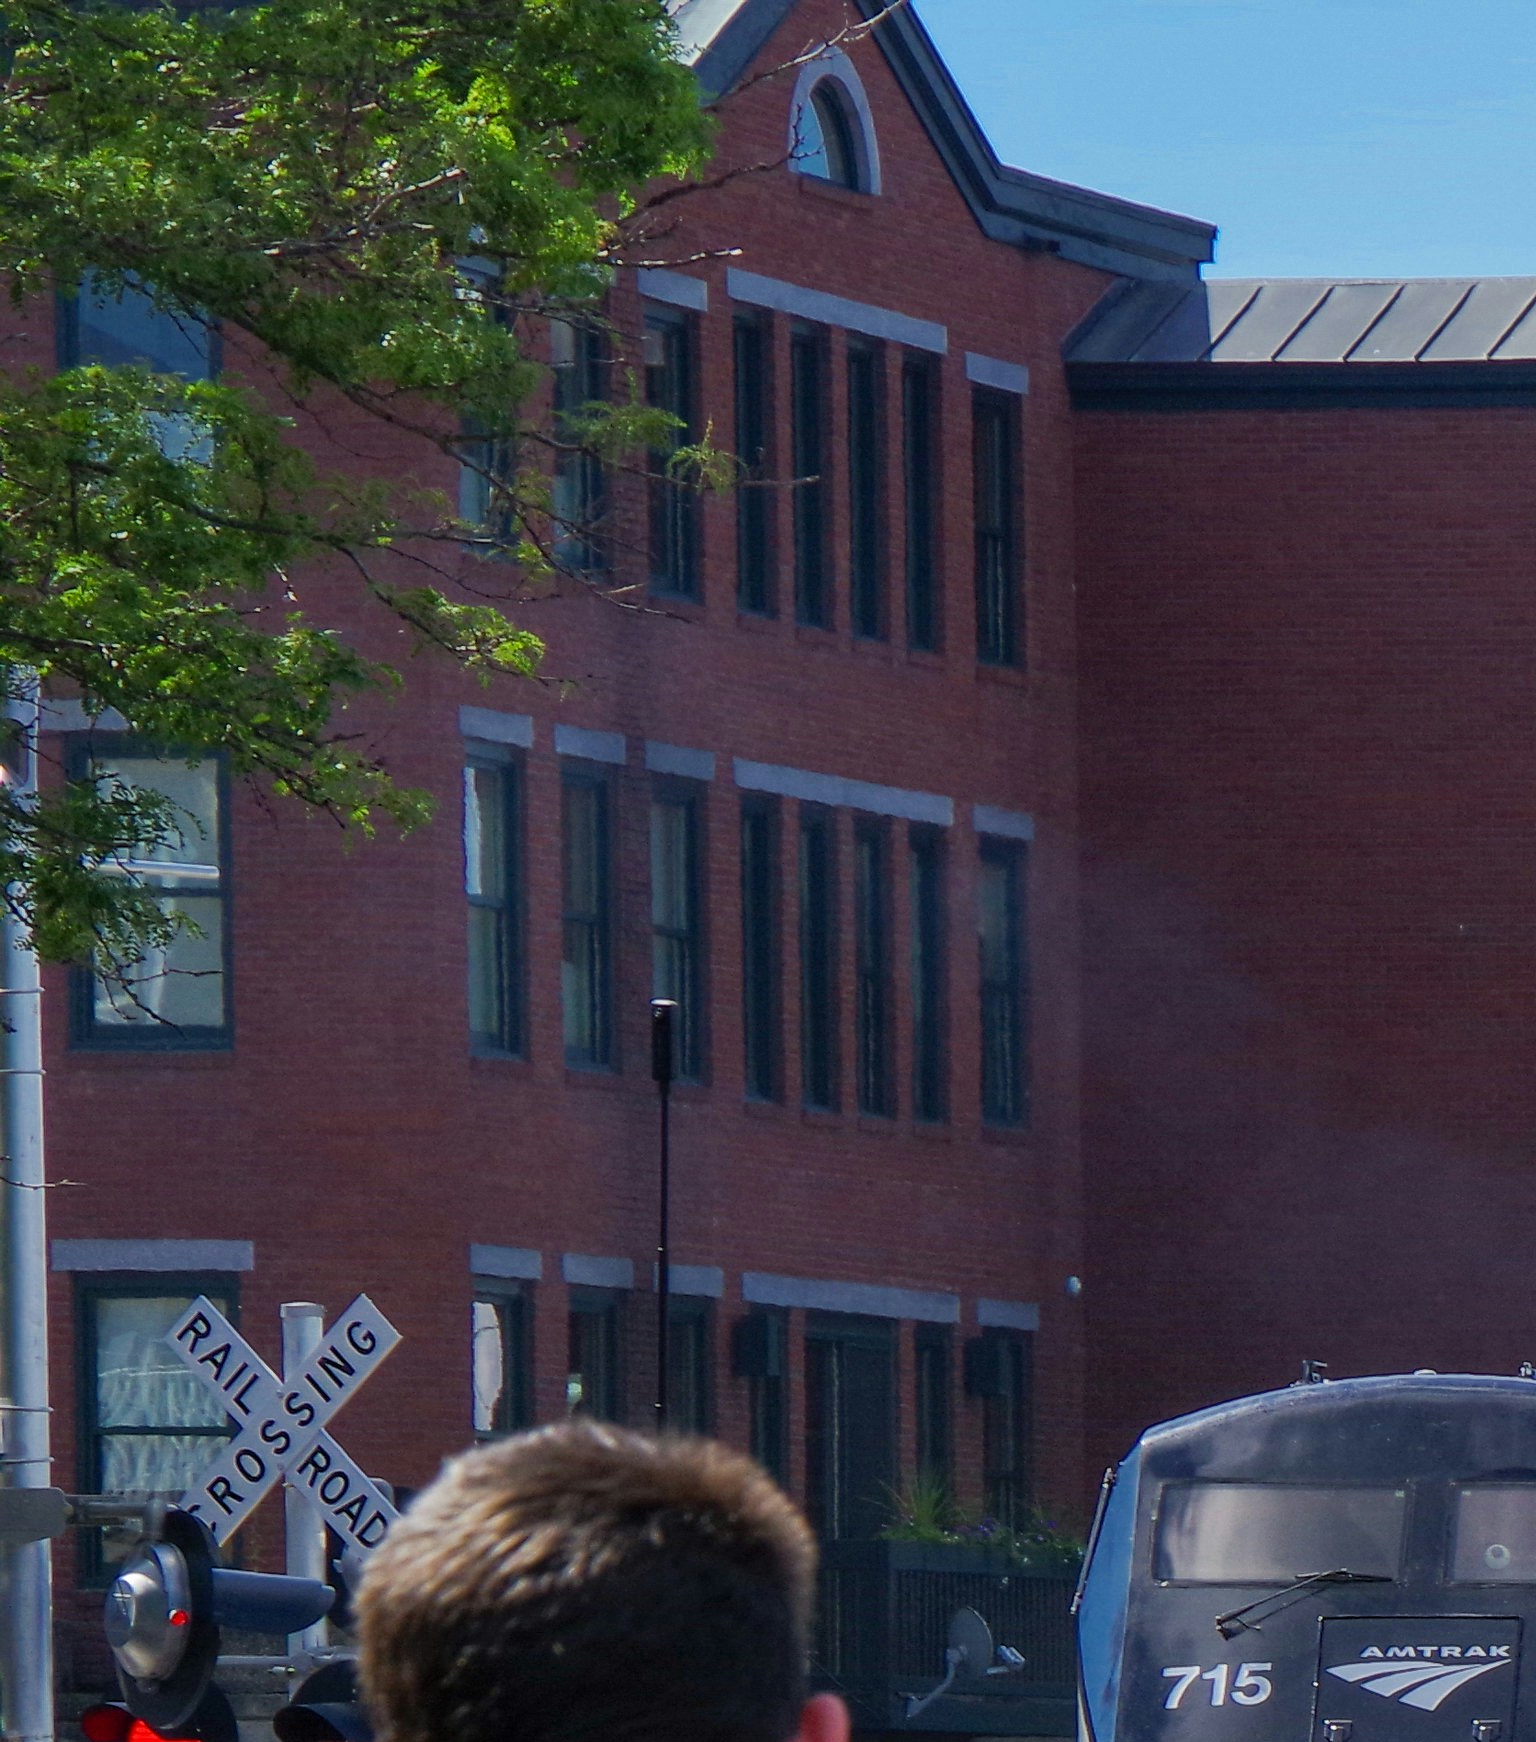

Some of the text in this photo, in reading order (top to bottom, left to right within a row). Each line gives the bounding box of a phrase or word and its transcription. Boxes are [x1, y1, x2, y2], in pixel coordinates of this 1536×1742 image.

[176, 1311, 260, 1416] RAIL
[187, 1321, 377, 1533] ROSSING
[296, 1444, 389, 1549] ROAD
[1161, 1662, 1274, 1711] 715
[1358, 1645, 1511, 1659] AMTRAK
